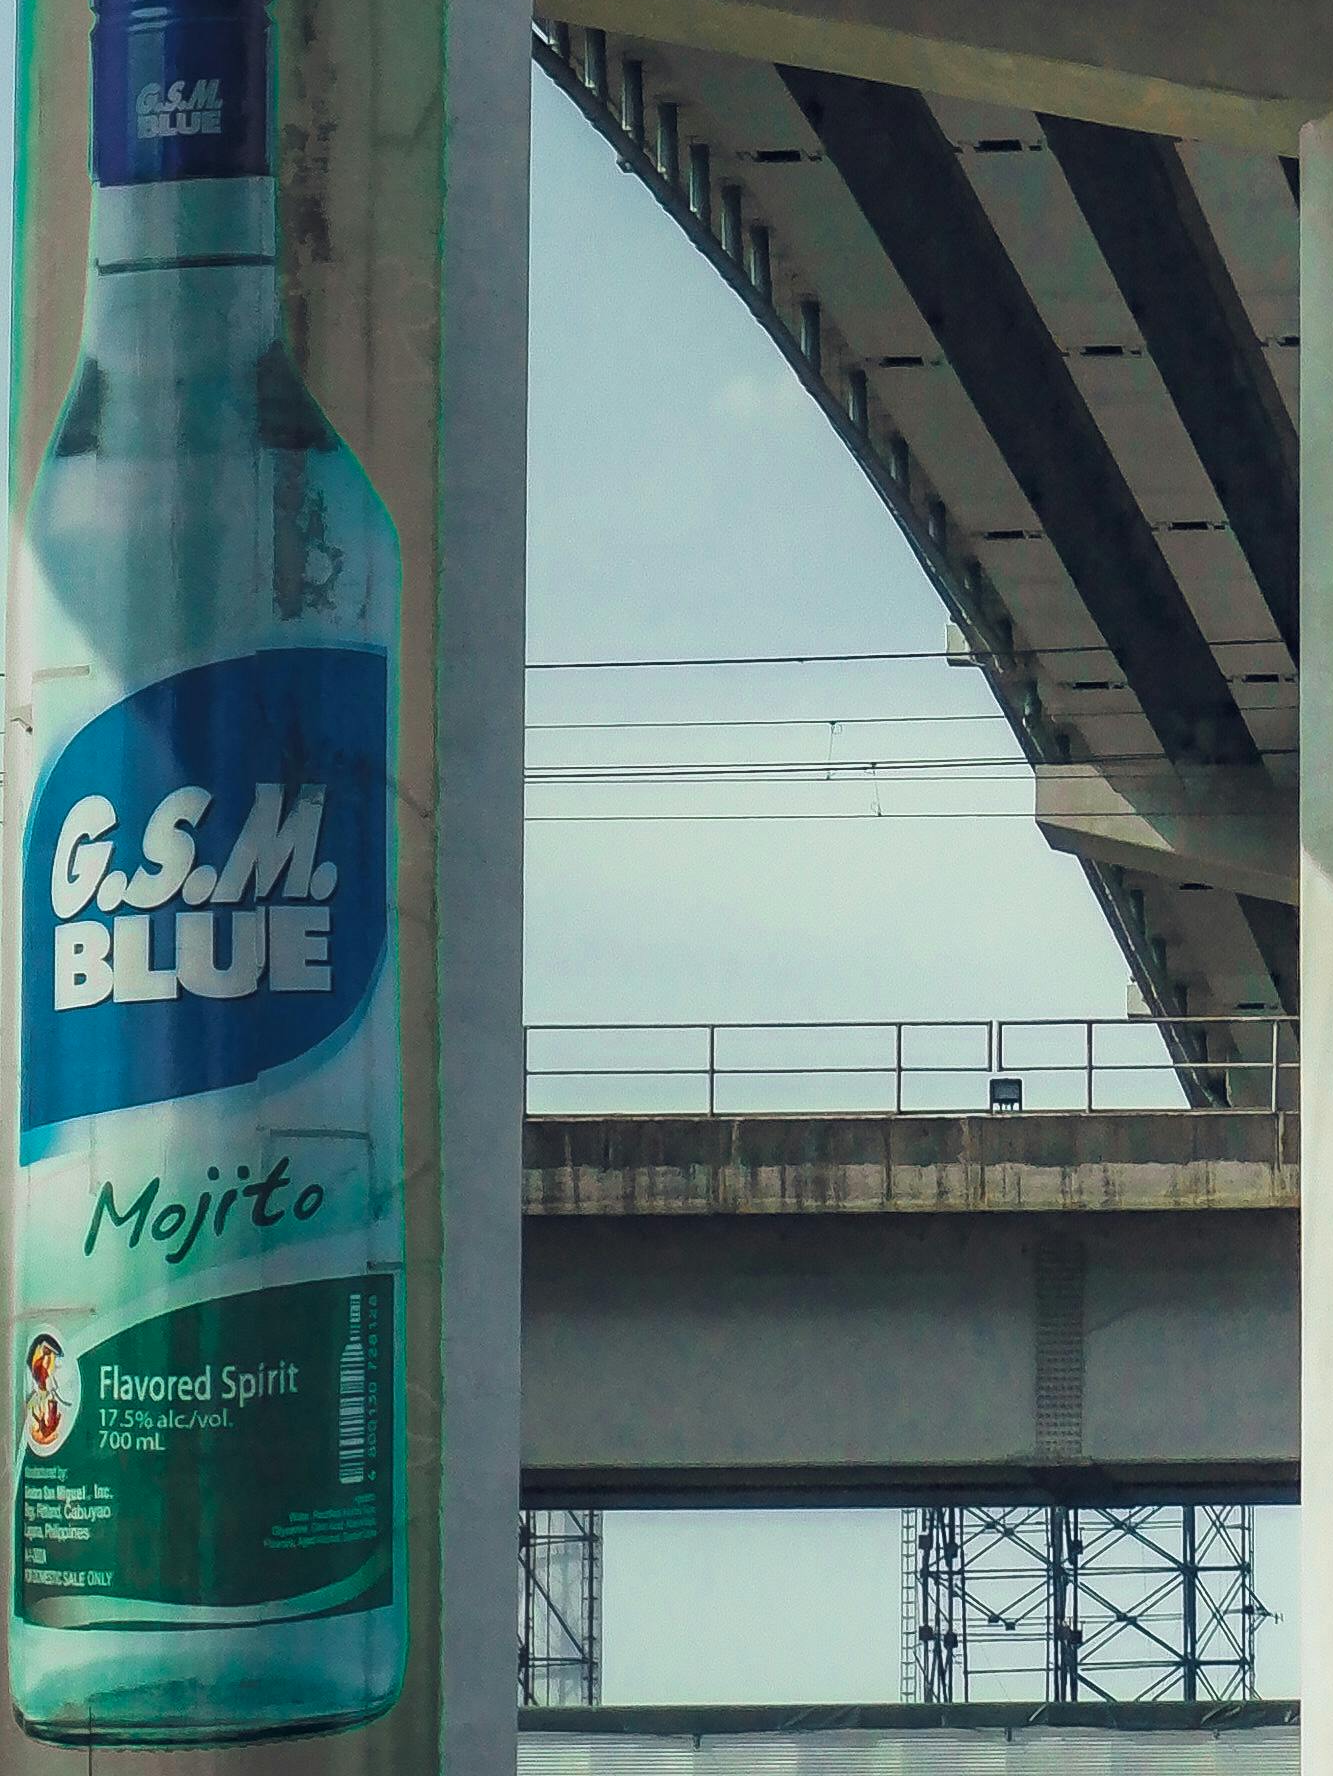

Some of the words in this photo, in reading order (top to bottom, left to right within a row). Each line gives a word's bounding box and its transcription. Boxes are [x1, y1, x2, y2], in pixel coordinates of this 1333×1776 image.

[137, 111, 222, 139] BLUE
[50, 782, 338, 920] G.S.M.
[53, 905, 332, 1012] BLUE
[83, 1156, 325, 1265] Mojito
[99, 1364, 211, 1402] Flavored
[221, 1360, 300, 1409] Spirit
[99, 1408, 154, 1430] 17.5%
[98, 1430, 132, 1450] 700
[135, 1432, 167, 1451] mL
[63, 1503, 111, 1523] Cabuyao
[87, 1570, 112, 1586] ONLY
